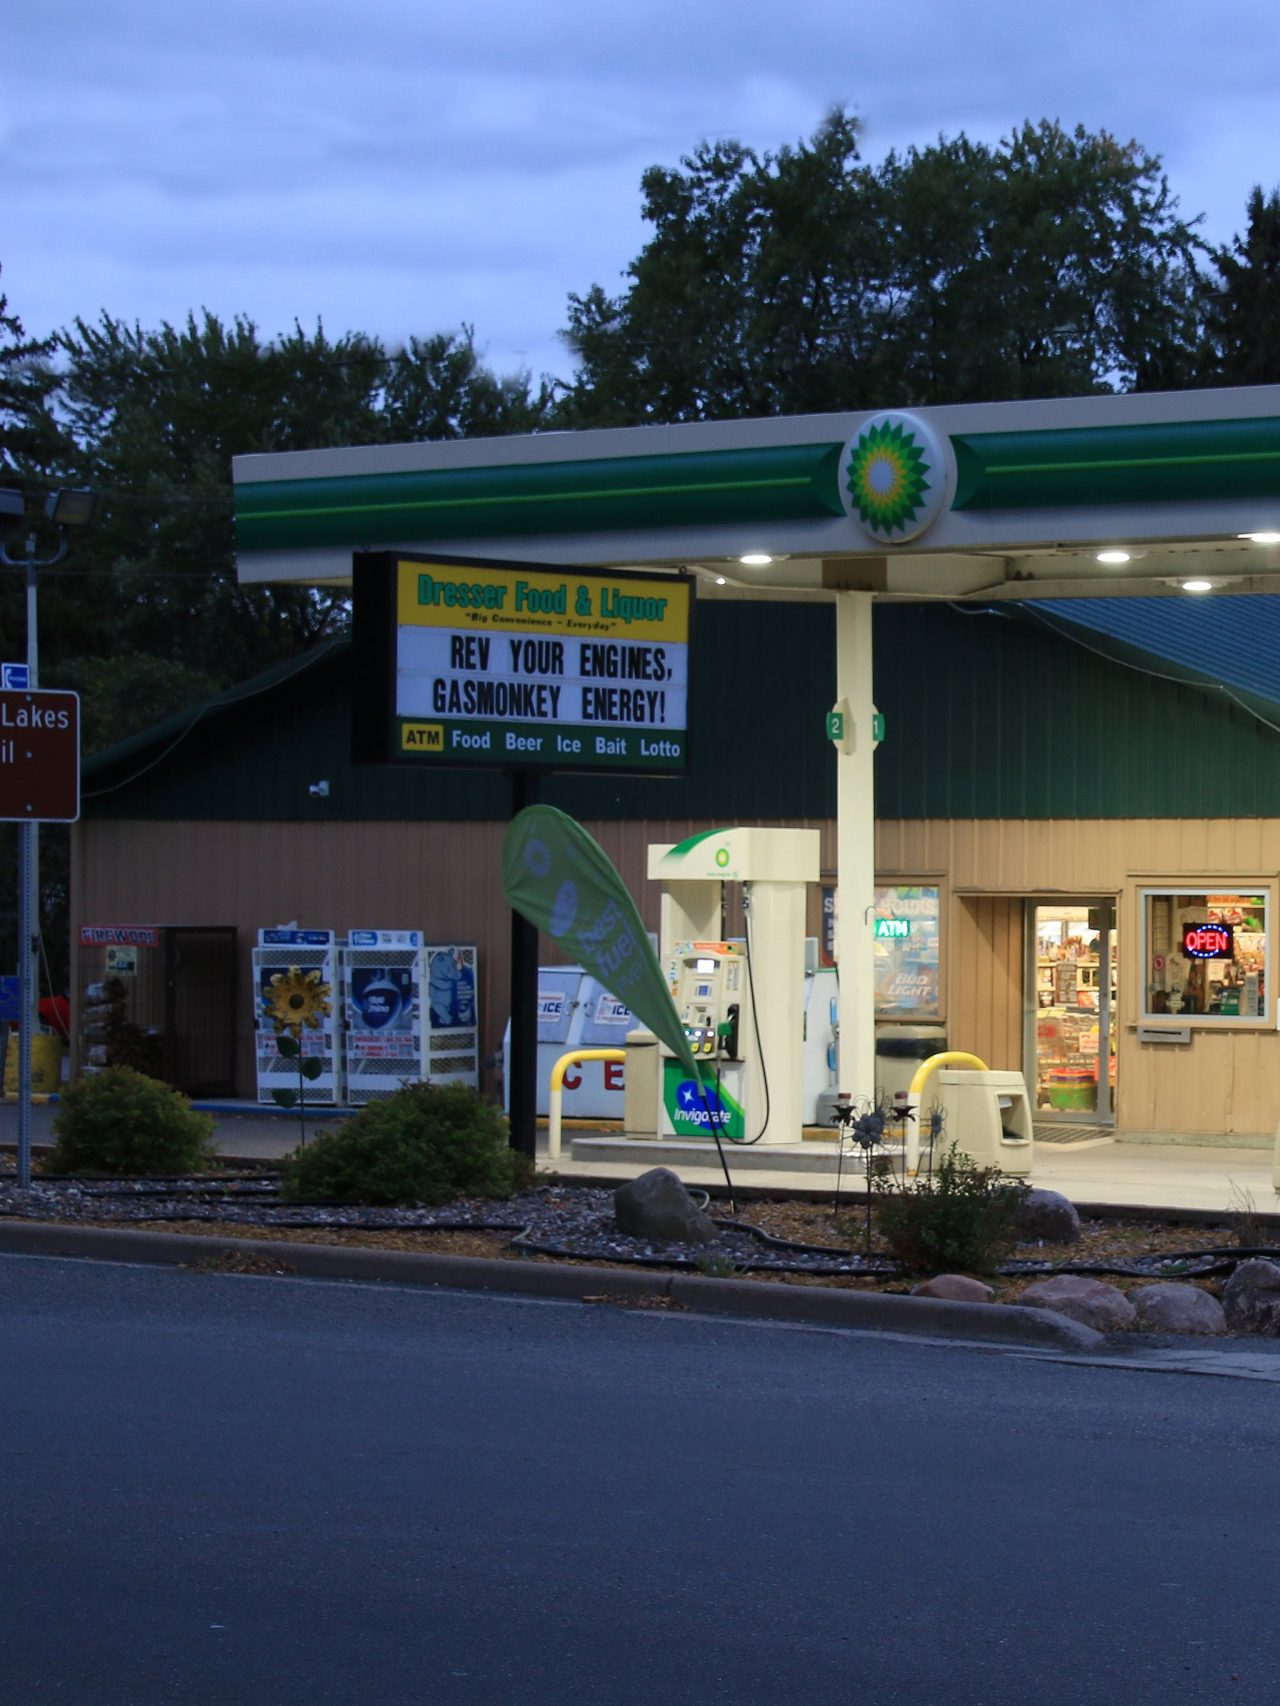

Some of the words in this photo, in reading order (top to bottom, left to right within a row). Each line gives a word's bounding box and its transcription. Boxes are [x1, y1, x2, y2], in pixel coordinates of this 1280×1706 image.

[418, 574, 507, 610] Dresser
[515, 581, 567, 614] Food
[575, 585, 592, 616] &
[601, 587, 668, 624] Liquor
[492, 614, 552, 626] Convenience
[451, 635, 490, 671] REV
[510, 639, 564, 674] YOUR
[432, 678, 561, 719] GASMONKEY
[582, 687, 666, 723] ENERGY!
[2, 703, 69, 729] Lakes
[832, 718, 840, 734] 2
[873, 720, 879, 734] 1
[406, 729, 440, 746] ATM
[452, 730, 490, 749] Food
[506, 732, 542, 751] Beer
[557, 735, 582, 753] Ice
[596, 737, 627, 755] Bait
[640, 739, 681, 757] Lotto
[878, 920, 908, 936] ATM
[1186, 932, 1227, 950] OPEN
[895, 974, 928, 985] BUD
[888, 984, 931, 996] LIGHT
[542, 1002, 562, 1013] ICE
